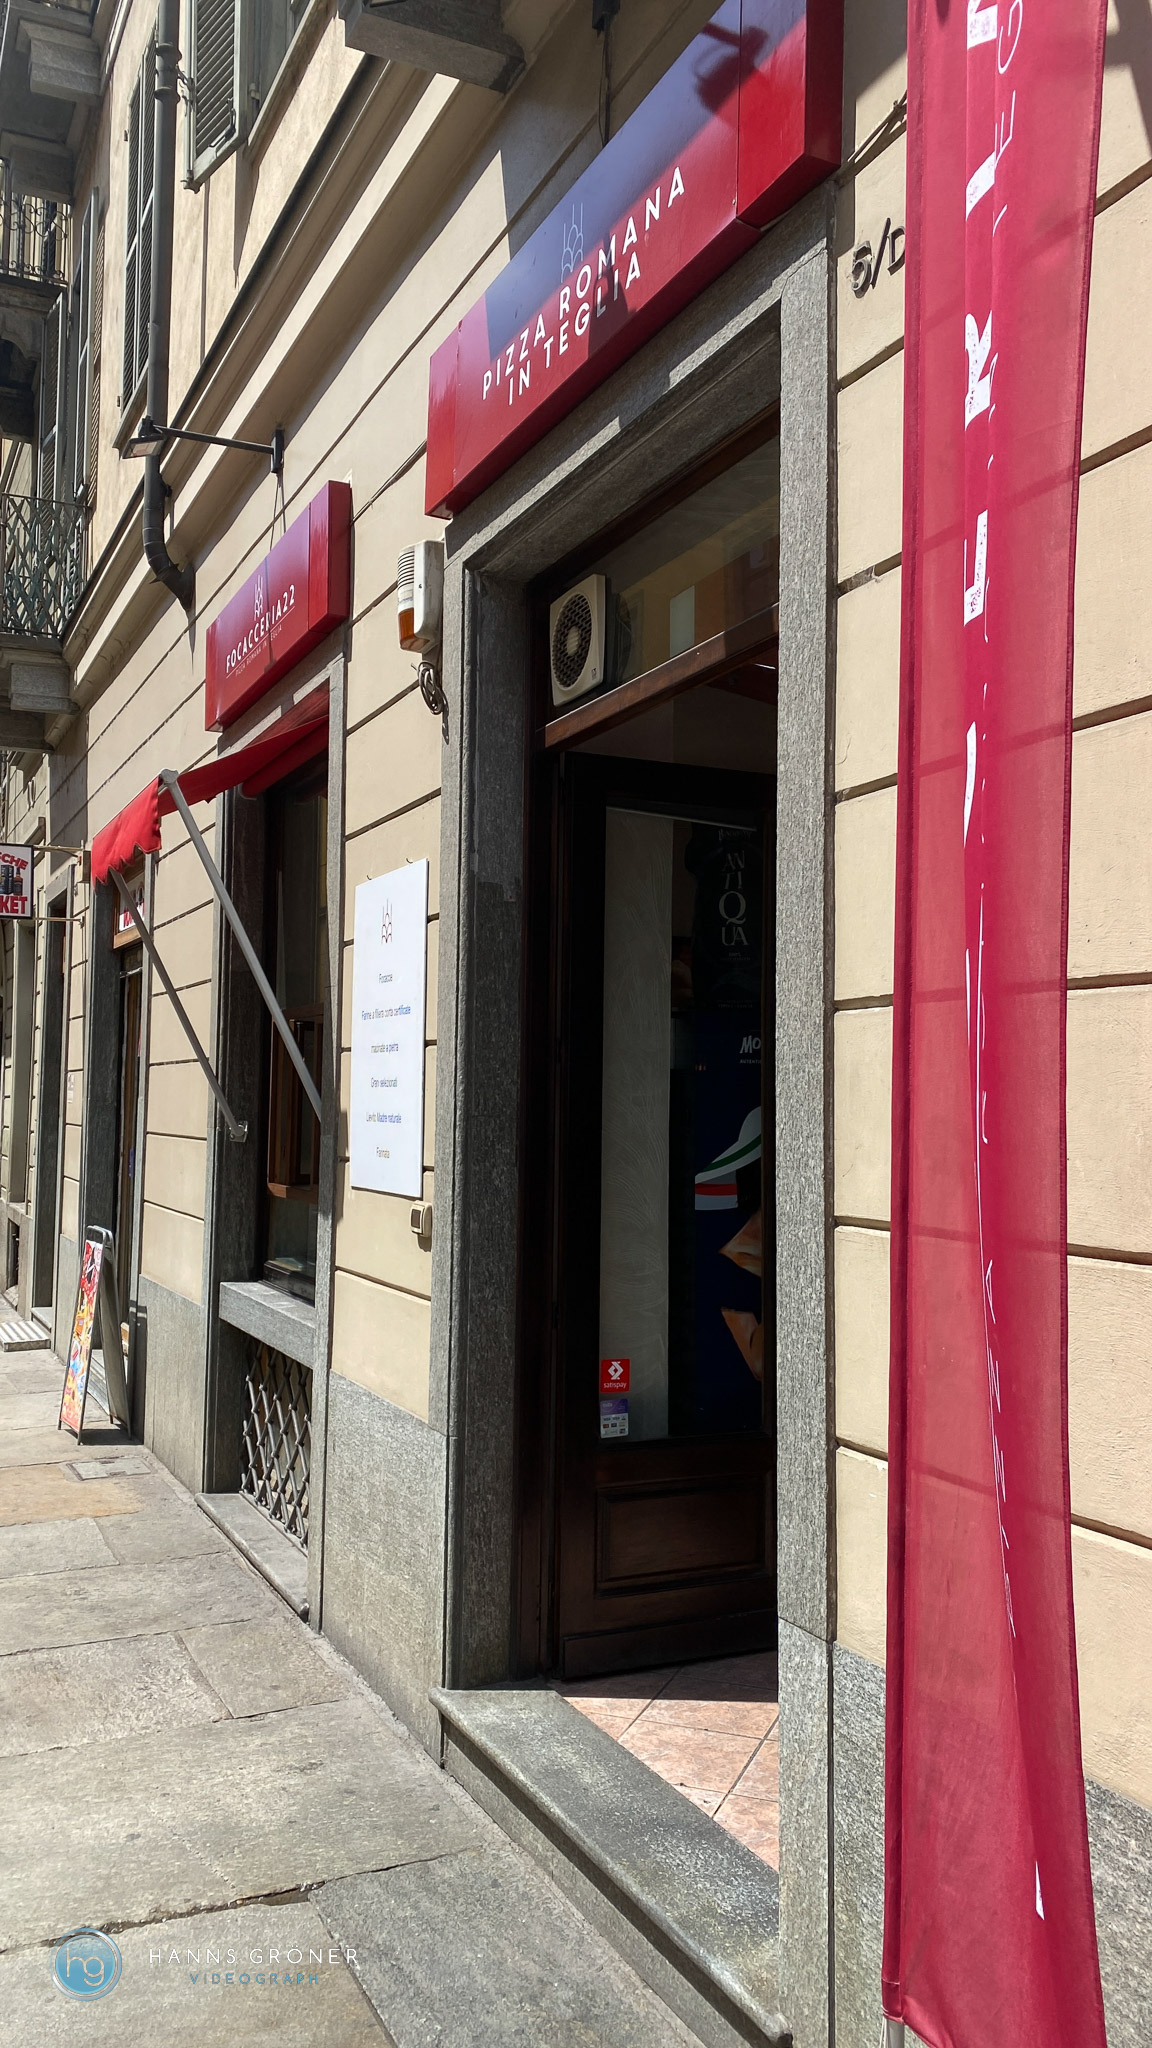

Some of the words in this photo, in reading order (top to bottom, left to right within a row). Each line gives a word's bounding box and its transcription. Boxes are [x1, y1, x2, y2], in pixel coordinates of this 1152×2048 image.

[482, 314, 546, 400] PIZZA
[559, 166, 685, 320] ROMANA
[508, 360, 531, 405] IN
[544, 251, 641, 368] TEGLIA
[226, 584, 295, 673] FOCACCERIA22
[235, 661, 246, 677] PIZZA
[246, 648, 262, 665] ROMANA
[718, 891, 747, 925] Q
